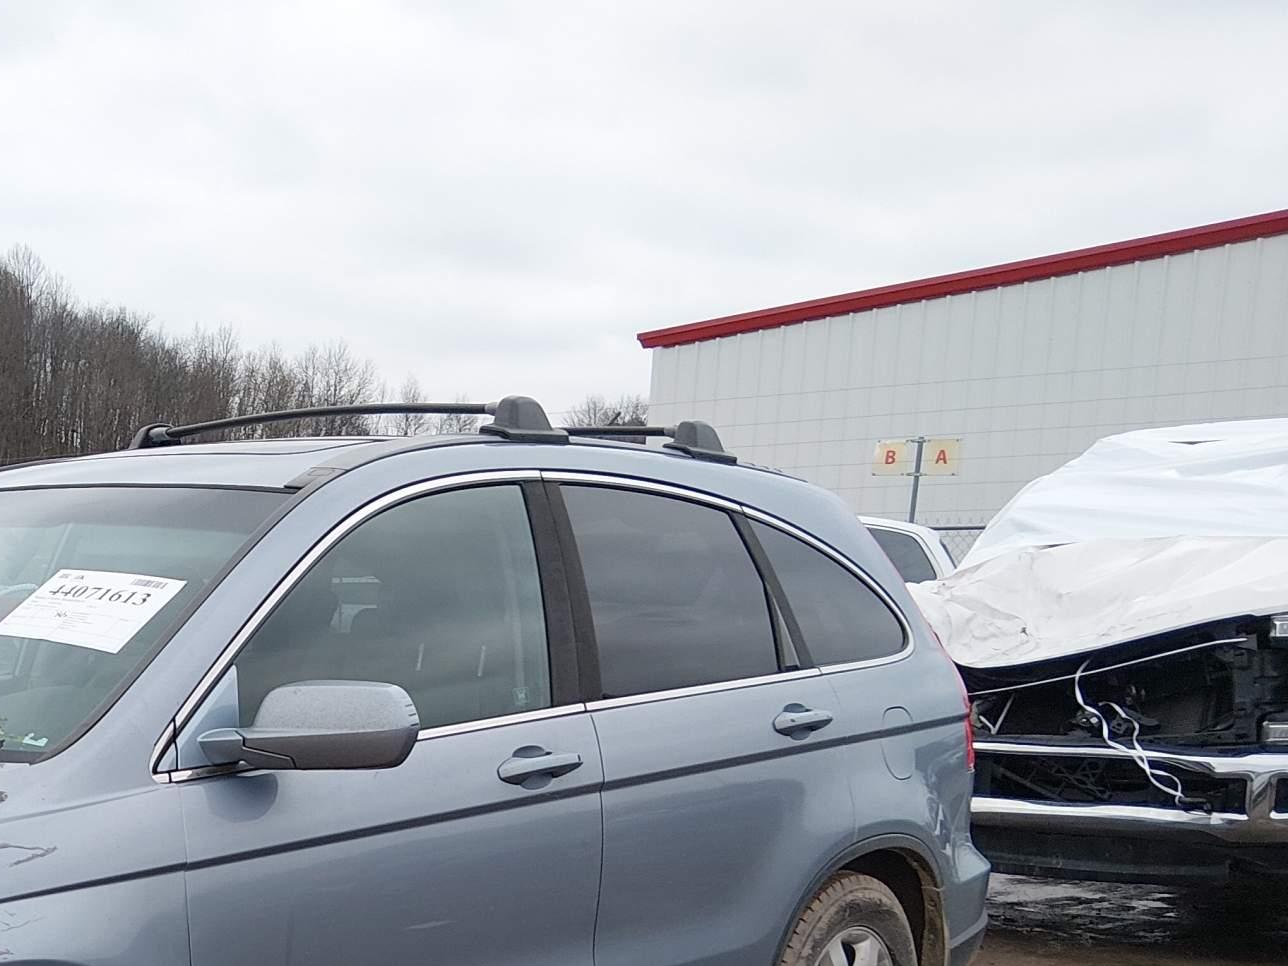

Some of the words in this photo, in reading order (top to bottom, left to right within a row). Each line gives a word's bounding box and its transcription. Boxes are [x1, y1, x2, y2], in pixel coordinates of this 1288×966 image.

[884, 449, 897, 465] B
[935, 449, 948, 465] A
[48, 583, 153, 607] 44071613
